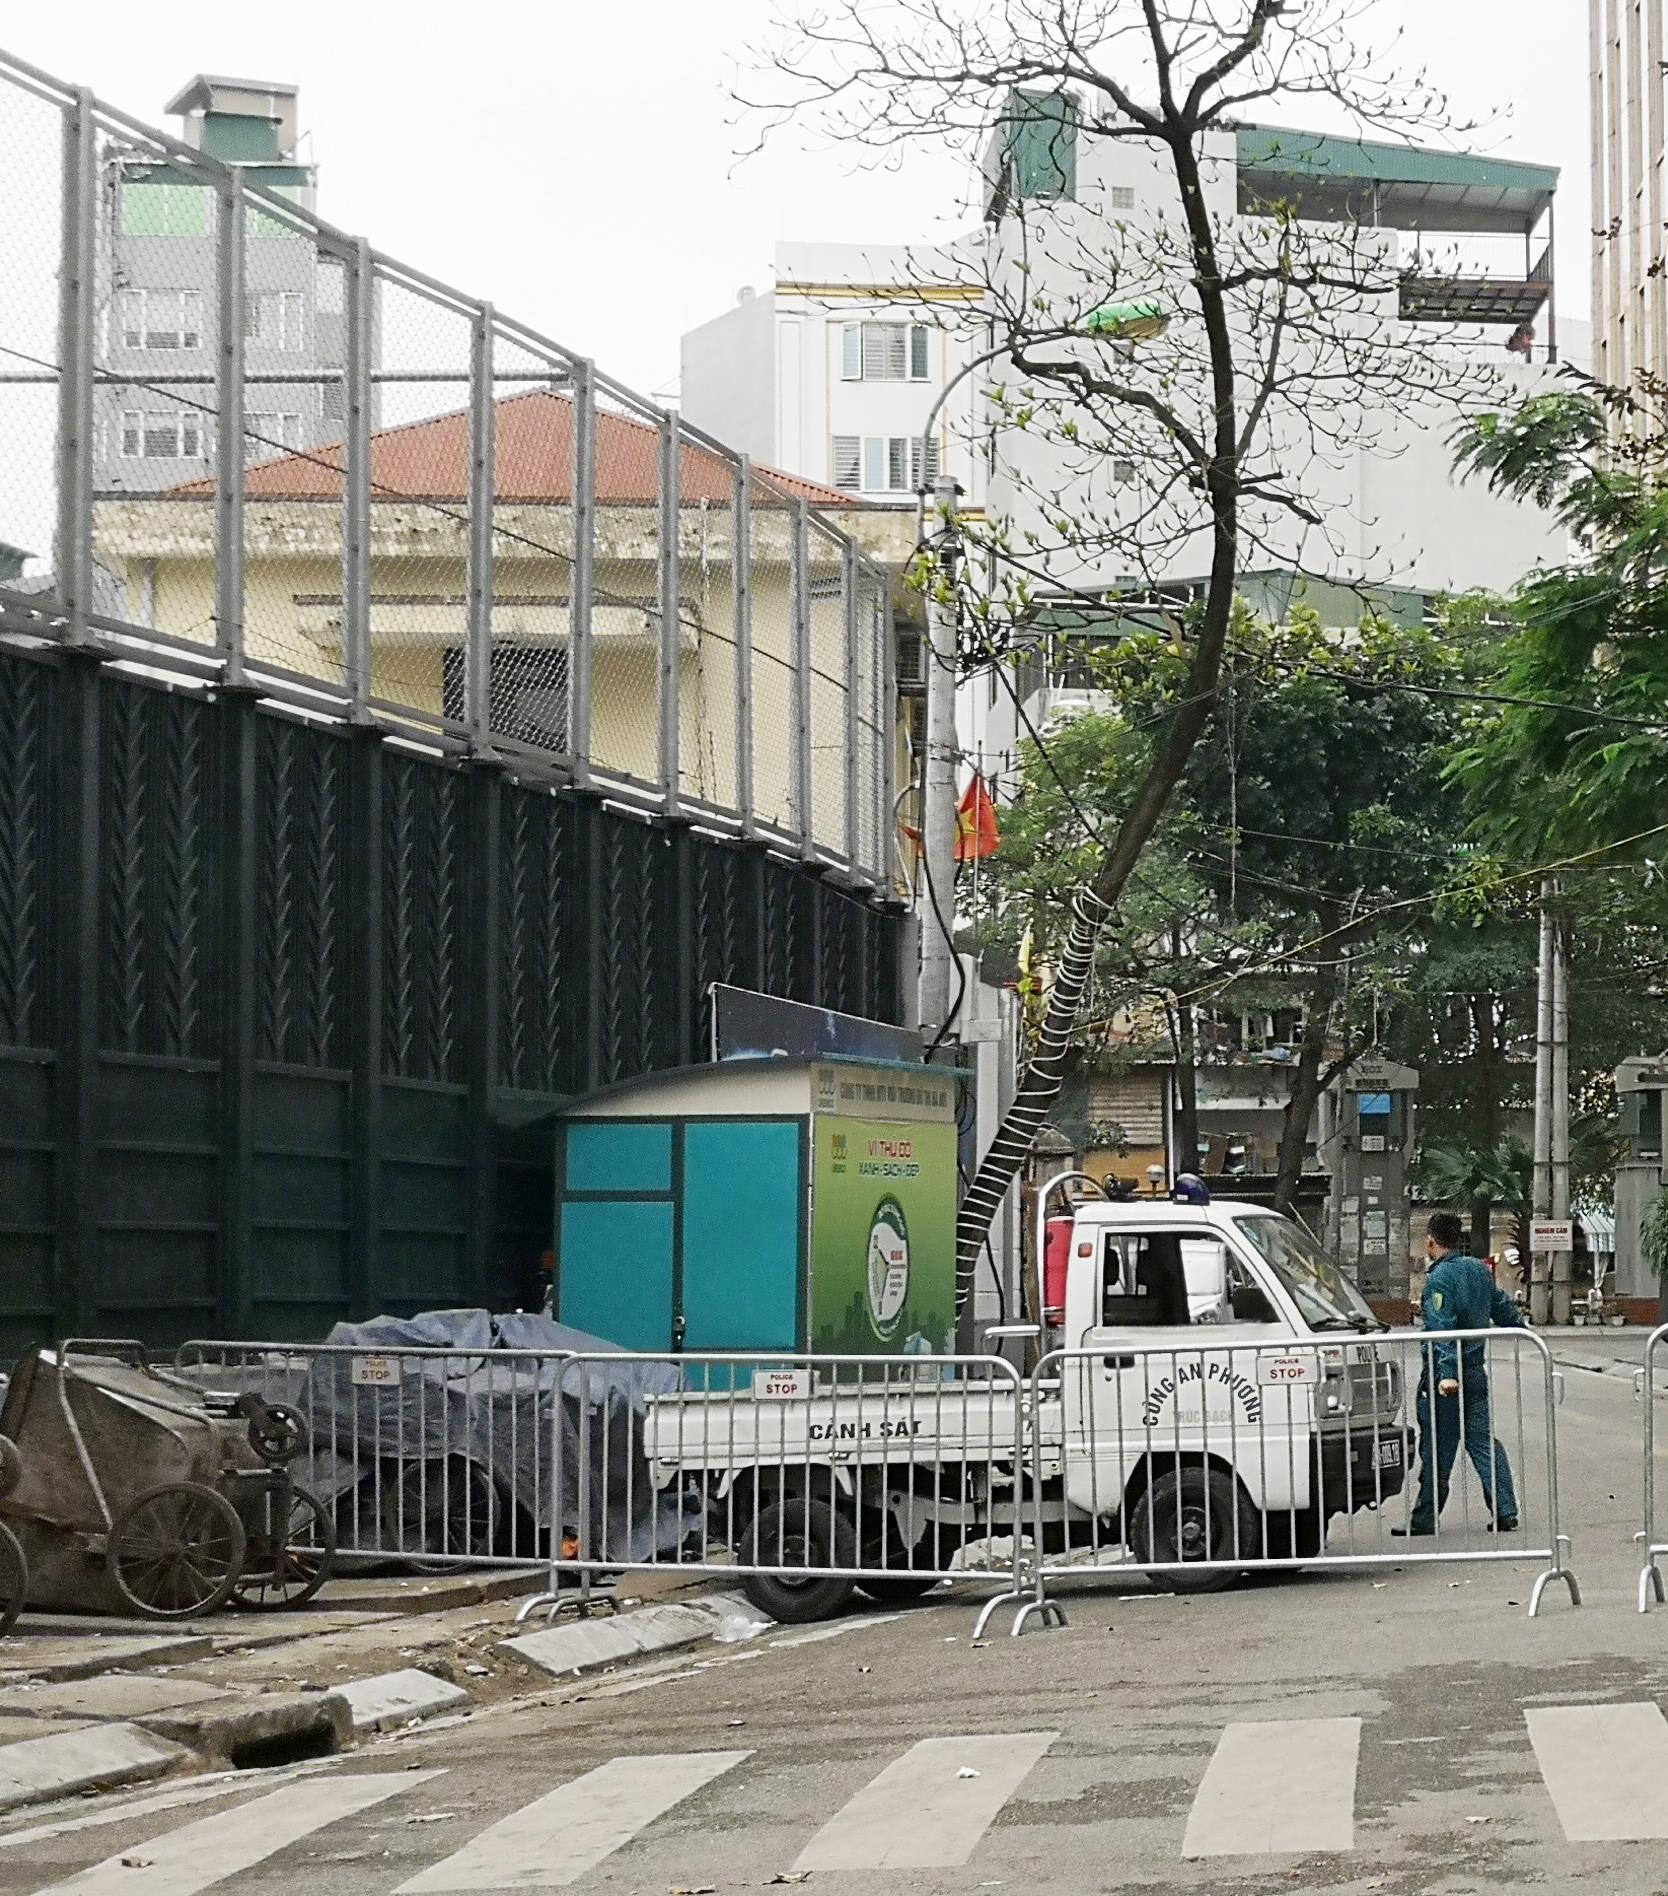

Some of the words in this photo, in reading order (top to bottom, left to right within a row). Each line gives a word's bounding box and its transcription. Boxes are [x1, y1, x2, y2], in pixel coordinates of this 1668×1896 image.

[362, 1370, 391, 1380] STOP
[1178, 1363, 1202, 1384] AN
[1270, 1368, 1306, 1380] STOP
[766, 1384, 798, 1394] STOP
